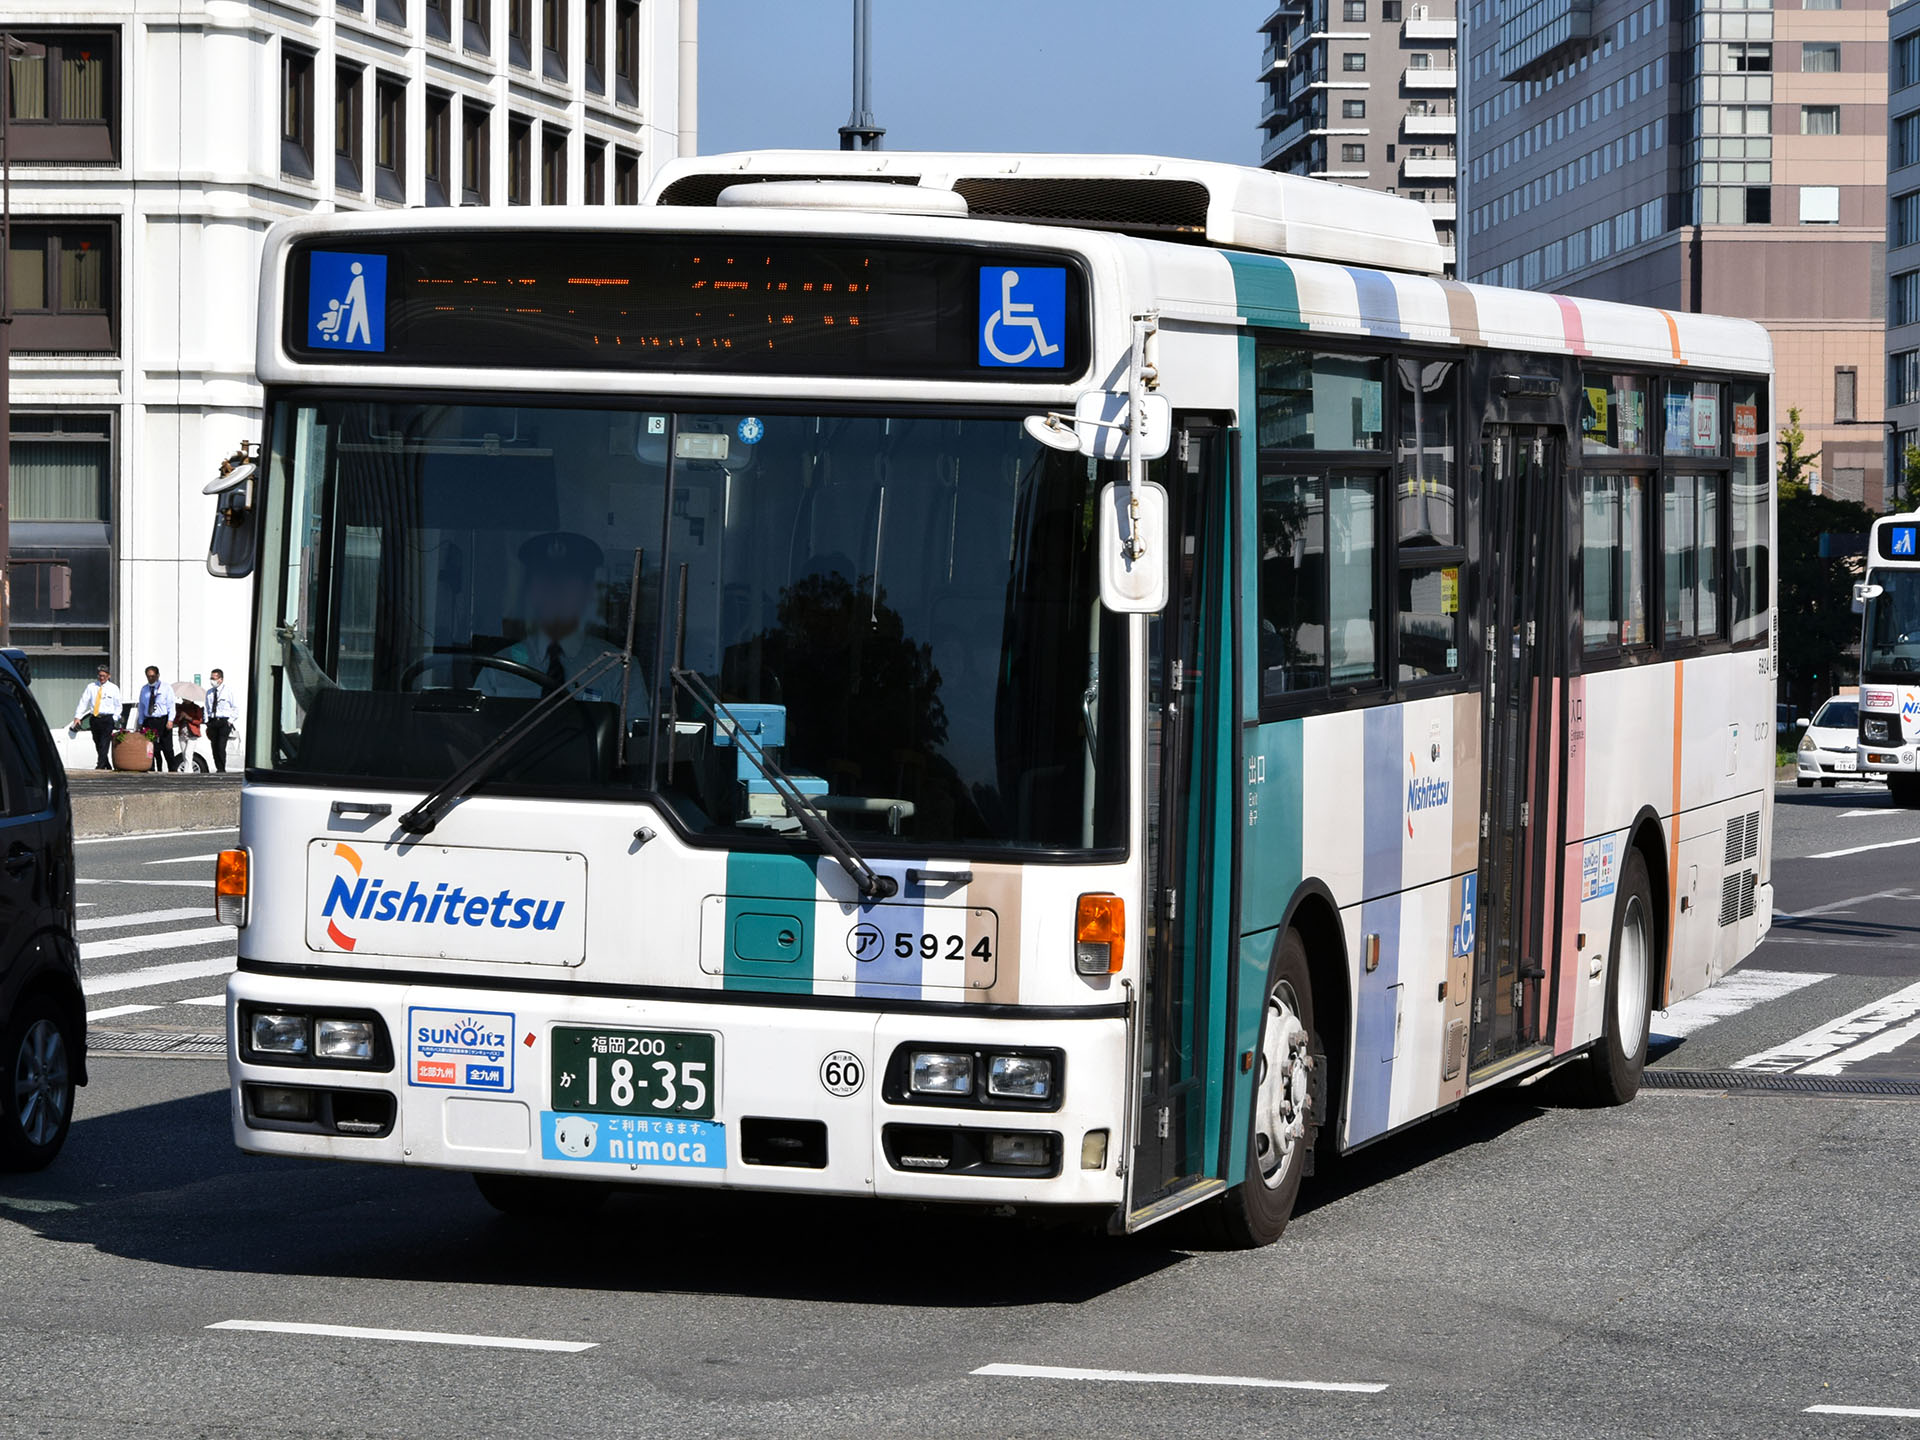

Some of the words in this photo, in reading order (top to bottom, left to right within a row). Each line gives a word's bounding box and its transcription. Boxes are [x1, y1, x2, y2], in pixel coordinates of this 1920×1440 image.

[655, 419, 662, 429] 8
[1248, 755, 1265, 785] 出口
[1903, 754, 1914, 762] 60
[1407, 776, 1450, 812] Nishitetsu
[321, 874, 565, 931] Nishitetsu
[894, 933, 992, 962] 5924
[419, 1066, 454, 1079] 北部九州
[470, 1069, 500, 1082] 全九州
[559, 1072, 576, 1088] か
[588, 1057, 707, 1111] 18-35
[825, 1061, 860, 1087] 60
[608, 1119, 707, 1137] ご利用できます。
[609, 1133, 707, 1163] nimoca
